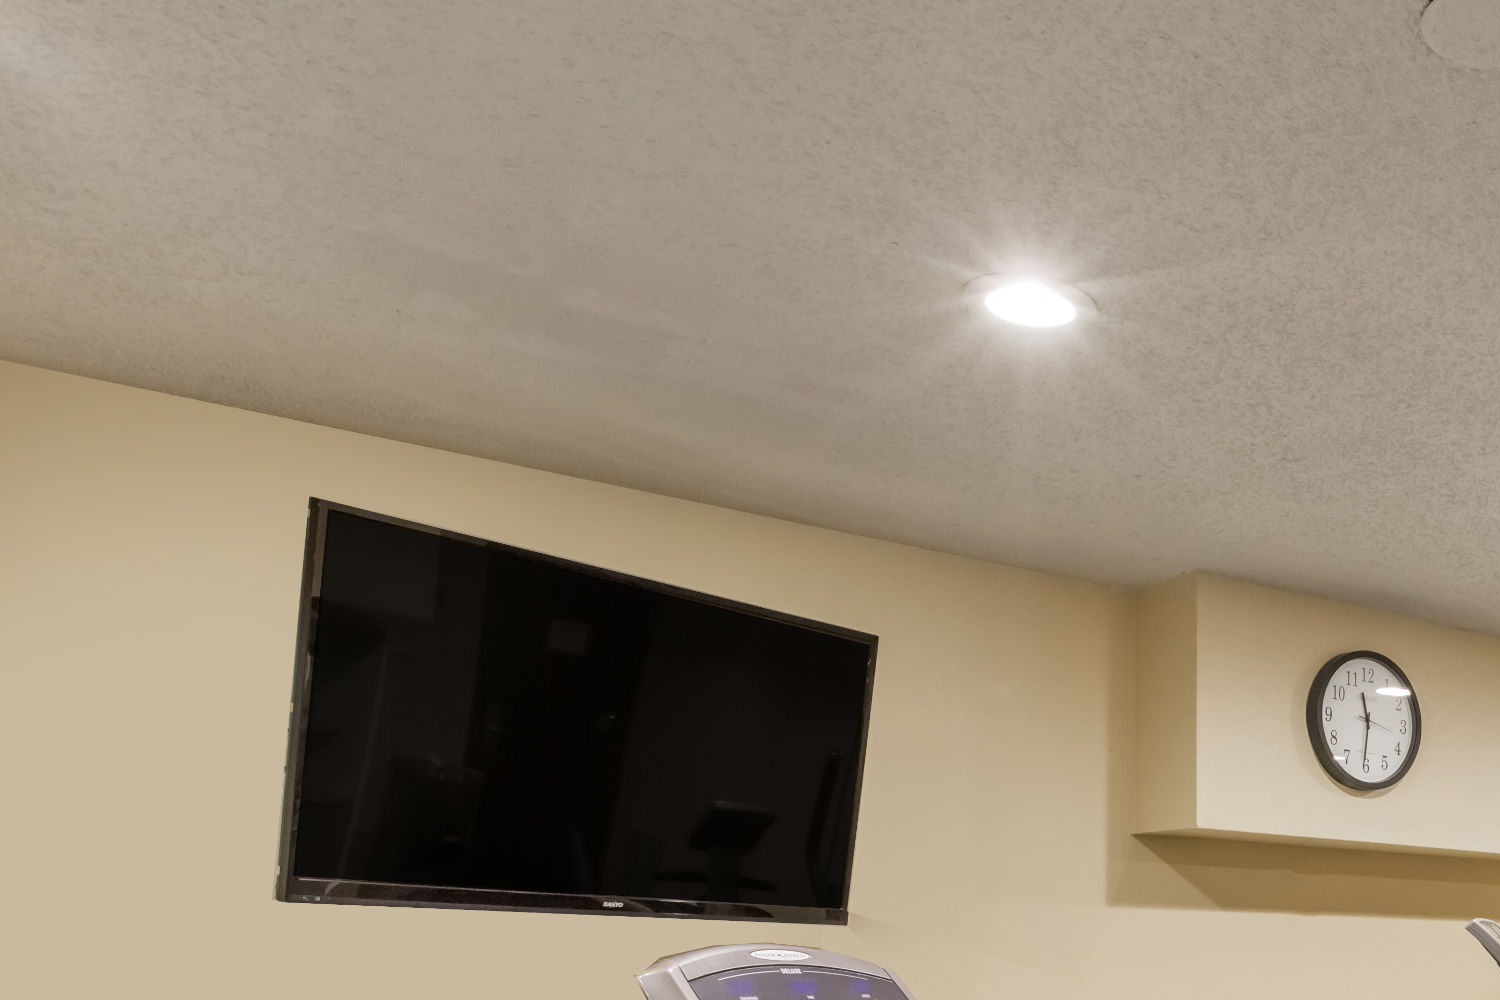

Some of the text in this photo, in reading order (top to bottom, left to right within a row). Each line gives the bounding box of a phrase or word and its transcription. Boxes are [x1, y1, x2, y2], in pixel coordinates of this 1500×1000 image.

[1345, 670, 1358, 687] 11
[1361, 667, 1375, 684] 12
[1332, 685, 1346, 702] 10
[1395, 696, 1403, 711] 2
[1324, 706, 1333, 722] 9
[1400, 719, 1407, 735] 3
[1330, 729, 1338, 746] 8
[1343, 748, 1351, 765] 7
[1394, 741, 1402, 756] 4
[1362, 758, 1370, 774] 6
[1381, 755, 1389, 771] 5
